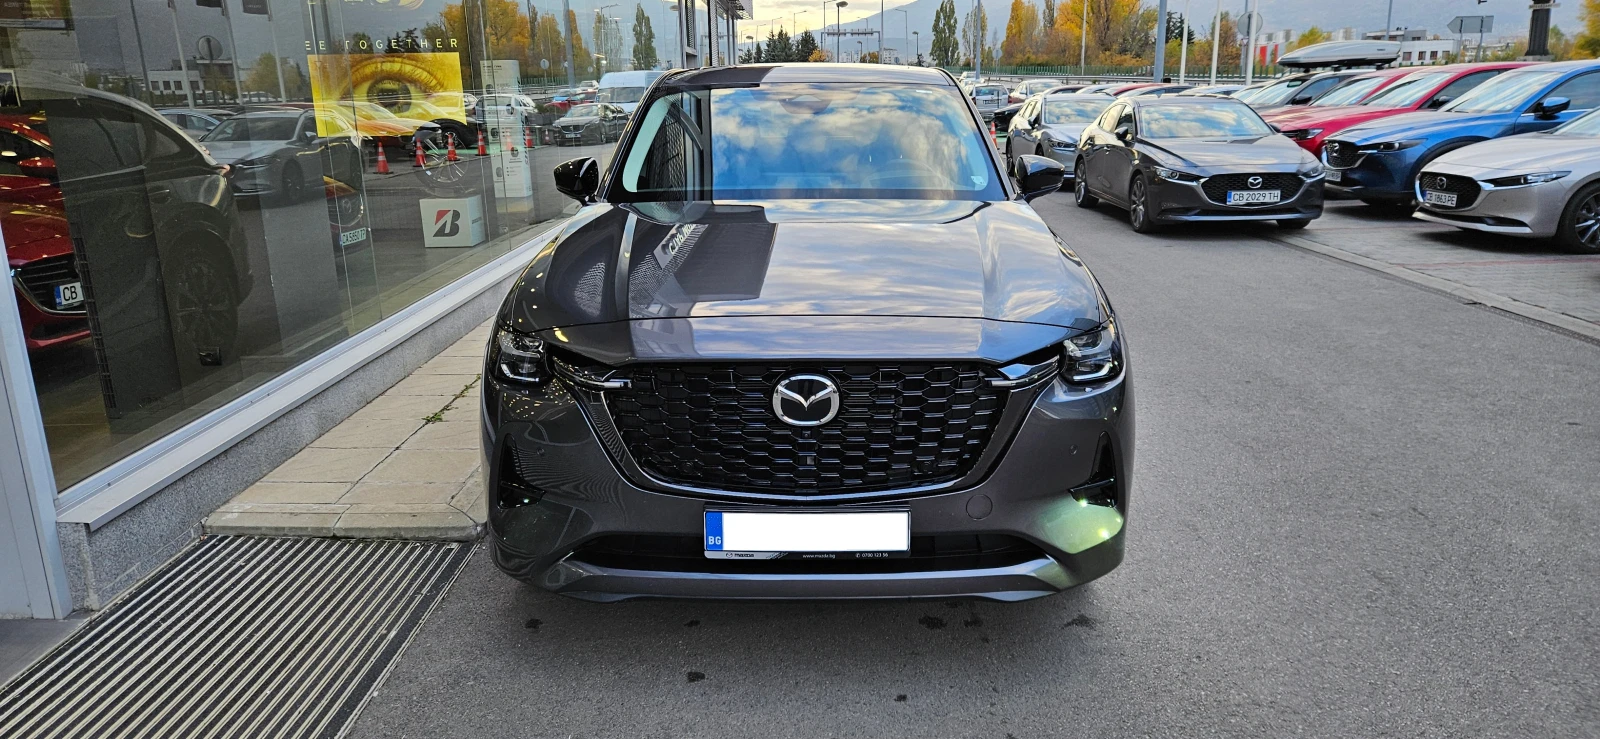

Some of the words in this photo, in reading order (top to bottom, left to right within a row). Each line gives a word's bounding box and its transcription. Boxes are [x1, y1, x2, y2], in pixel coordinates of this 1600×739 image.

[345, 38, 458, 50] TOGETHER
[1232, 193, 1244, 201] CB
[1245, 192, 1267, 201] 2029
[1268, 192, 1279, 201] TH
[63, 285, 78, 302] CB
[708, 536, 722, 545] BG
